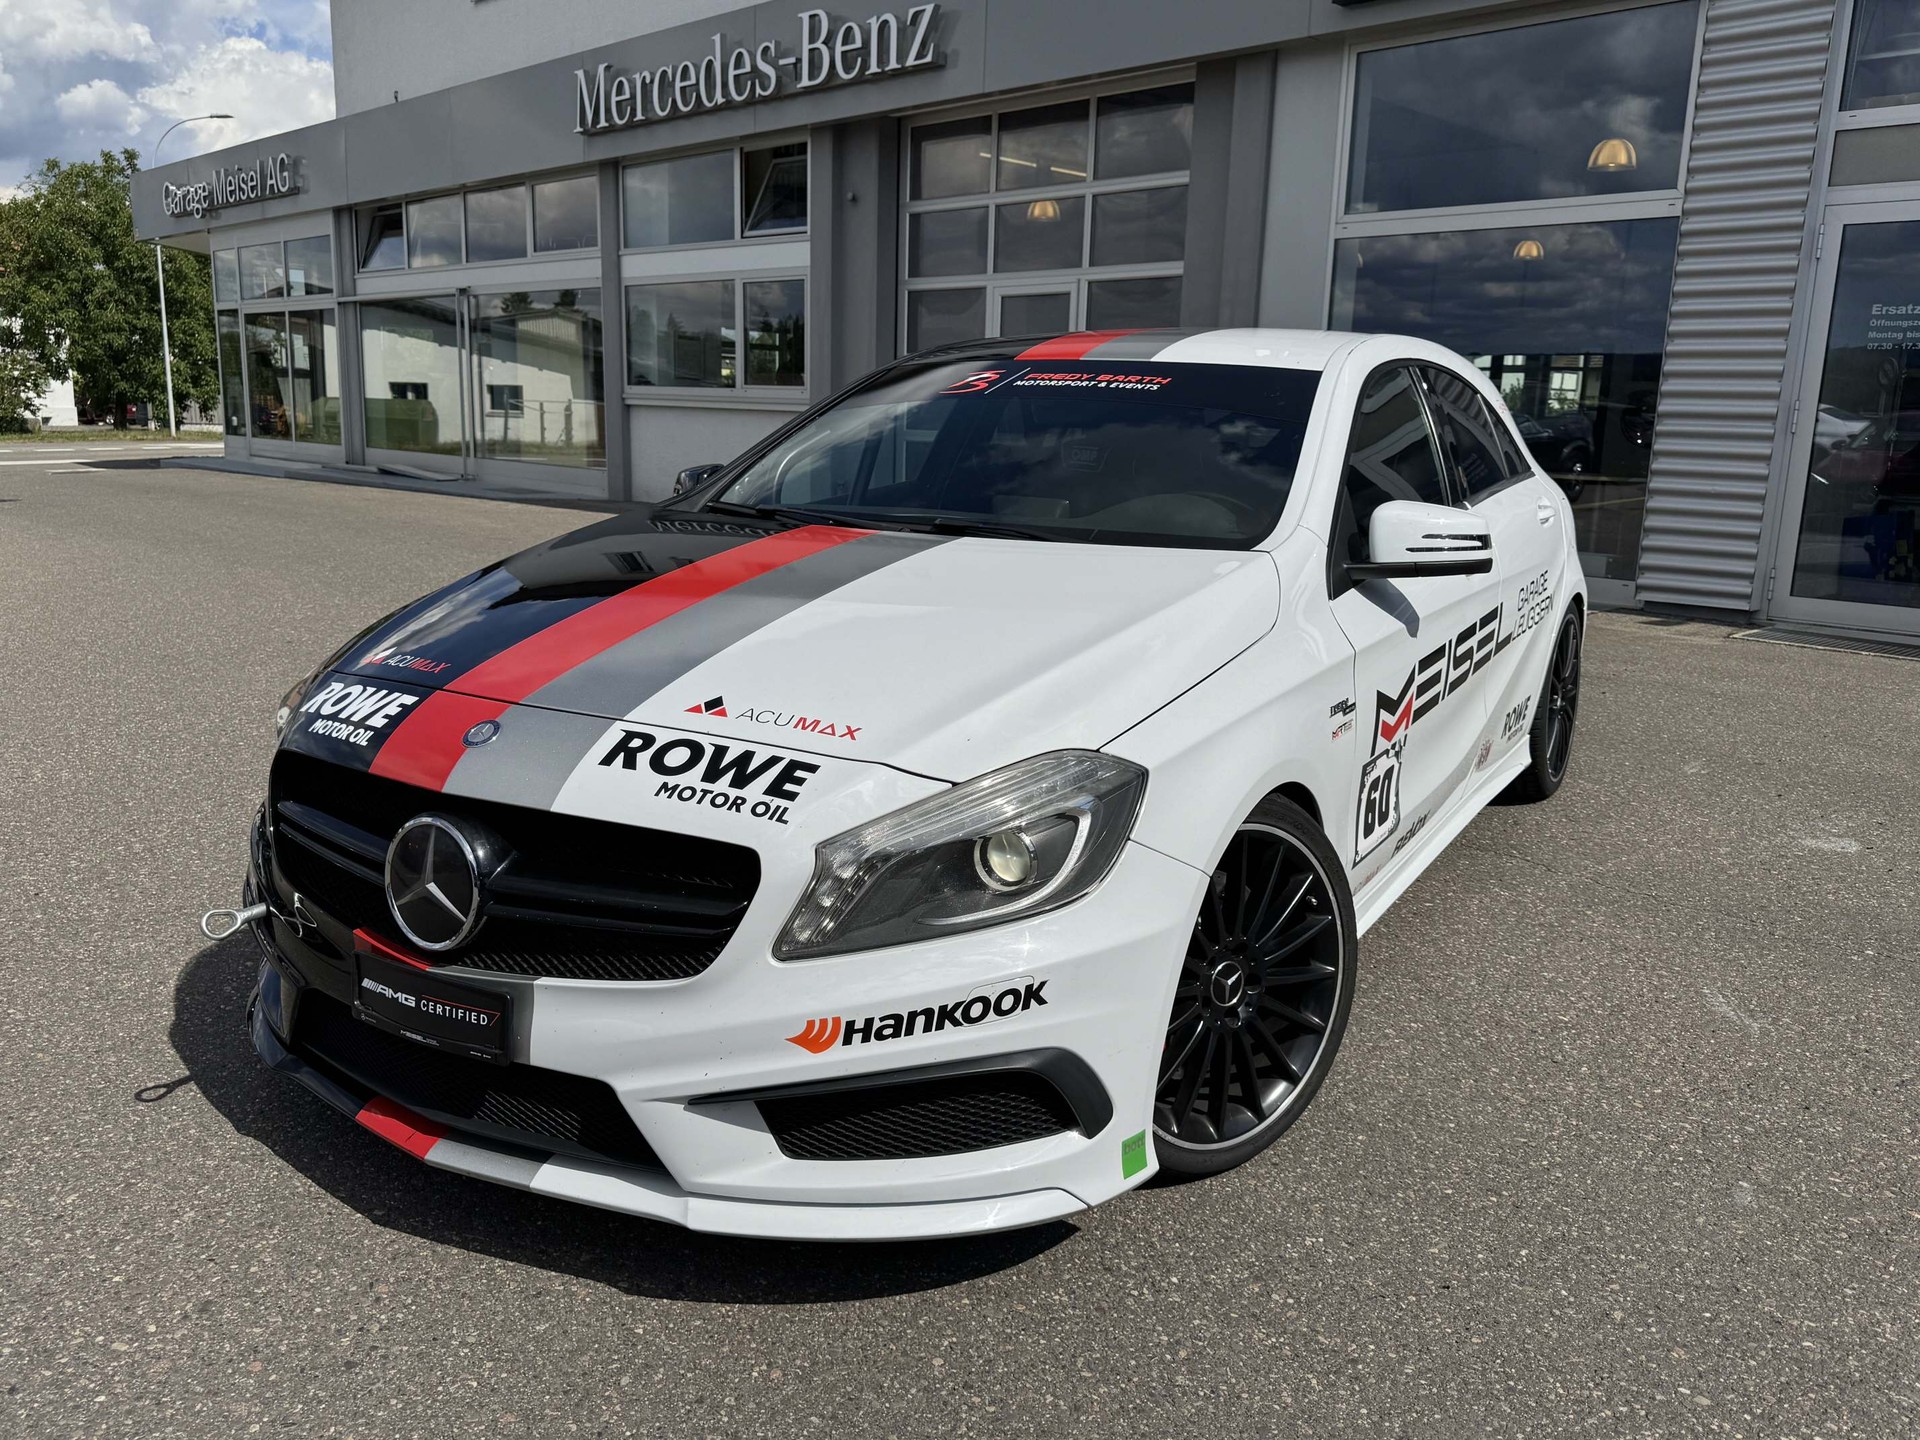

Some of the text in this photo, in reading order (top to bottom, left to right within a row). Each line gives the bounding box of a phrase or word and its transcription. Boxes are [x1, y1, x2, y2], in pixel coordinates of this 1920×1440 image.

[573, 2, 942, 134] Mercedes-Benz
[162, 153, 289, 219] Garage Meisel AG
[1867, 331, 1904, 340] Montag
[1867, 342, 1893, 350] 07.30
[1012, 379, 1098, 388] MOTORSPORT
[1109, 382, 1161, 391] EVENTS
[1024, 373, 1172, 385] FREDY BARTH
[1517, 569, 1549, 612] GARAGE
[381, 654, 452, 674] ACUMAX
[1369, 601, 1513, 759] MEISEL
[299, 681, 420, 729] ROWE
[735, 707, 863, 741] ACUMAX
[1500, 694, 1532, 740] ROWE
[308, 718, 375, 747] MOTOR OIL
[597, 728, 822, 803] ROWE
[653, 781, 790, 825] MOTOR OIL
[1363, 763, 1396, 840] 60
[376, 982, 488, 1026] AMG CERTIFIED
